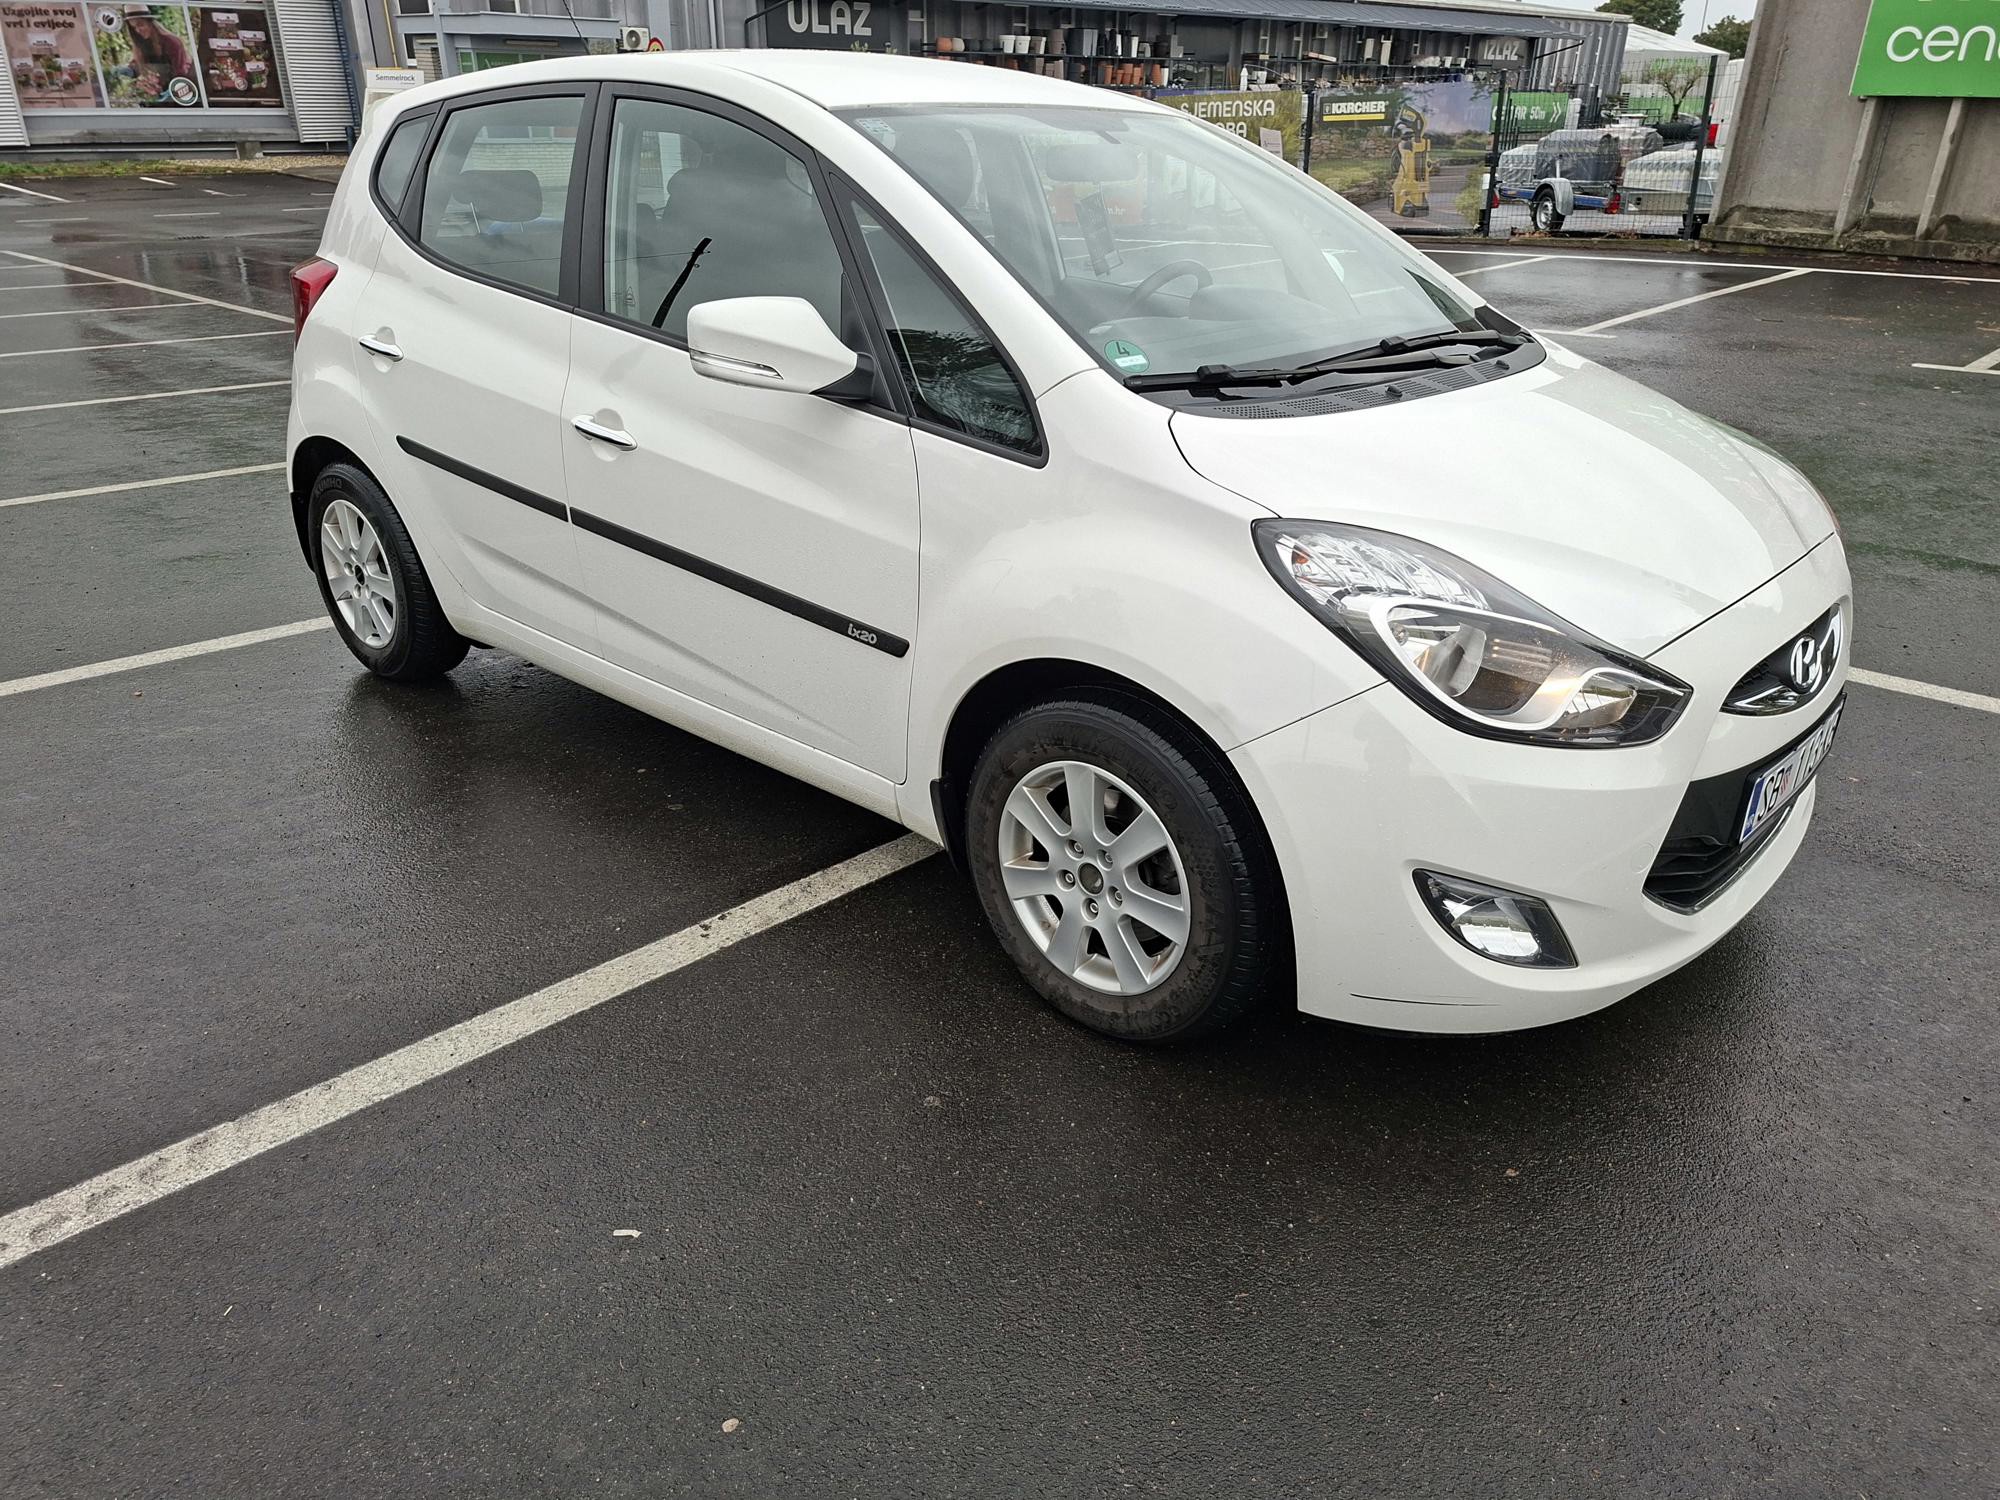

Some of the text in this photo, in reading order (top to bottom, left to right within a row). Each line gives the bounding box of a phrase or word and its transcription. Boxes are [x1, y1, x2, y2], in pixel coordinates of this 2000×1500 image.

[2, 6, 77, 18] Uzgojite svoj
[787, 0, 872, 36] ULAZ
[1483, 39, 1521, 61] IZLAZ
[1886, 25, 2000, 62] cen
[375, 73, 415, 81] Semmelrock
[1180, 99, 1275, 118] SJEMENSKA
[847, 623, 878, 644] ix20
[1757, 767, 1785, 821] SB
